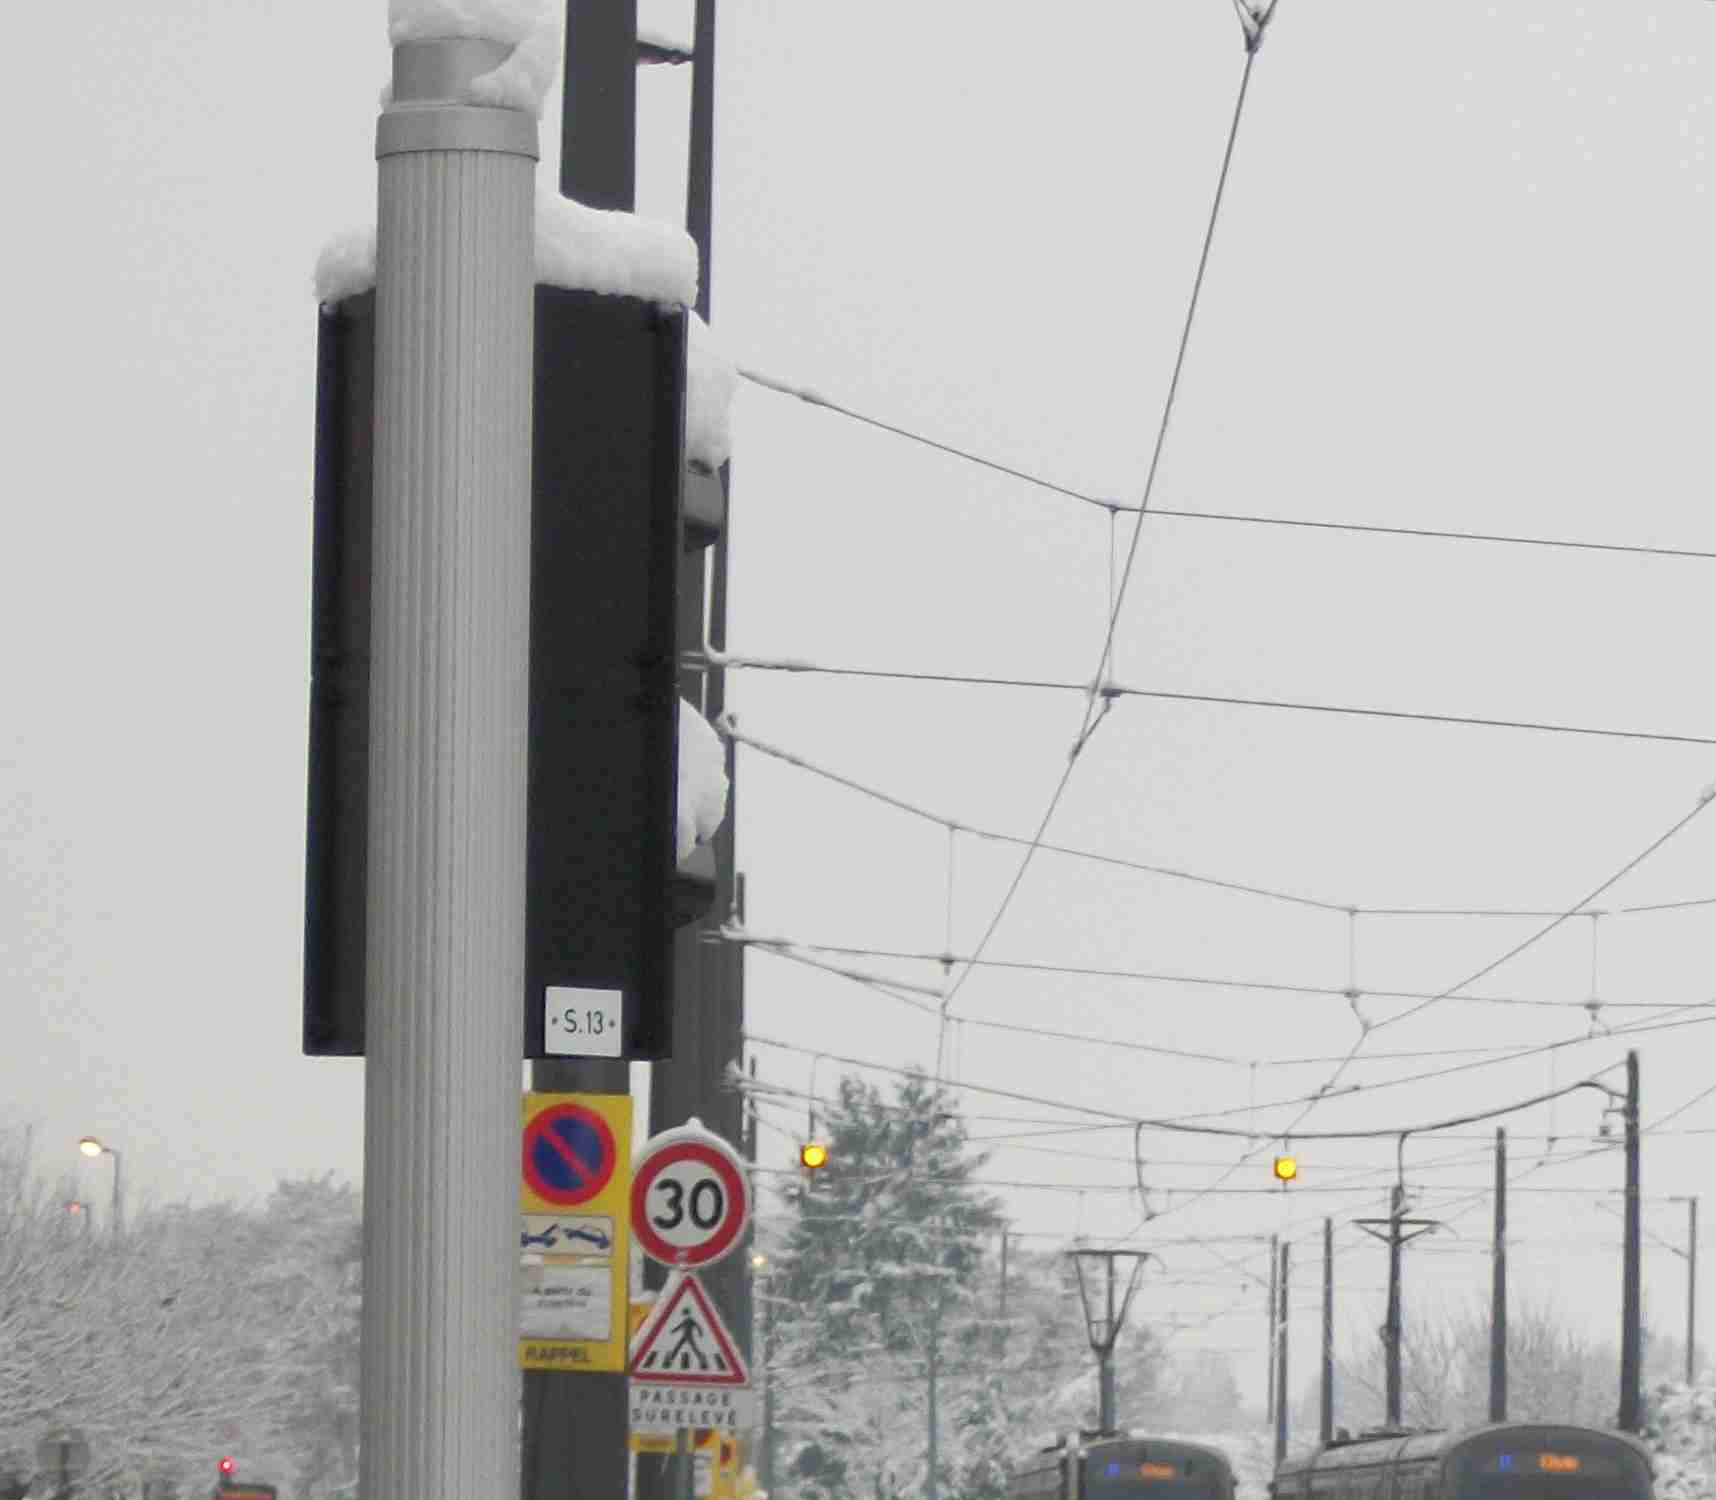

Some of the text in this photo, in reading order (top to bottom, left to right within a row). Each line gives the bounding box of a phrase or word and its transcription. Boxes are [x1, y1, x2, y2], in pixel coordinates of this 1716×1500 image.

[562, 1007, 604, 1035] S.13
[653, 1178, 723, 1230] 30
[639, 1389, 731, 1407] PASSAGE
